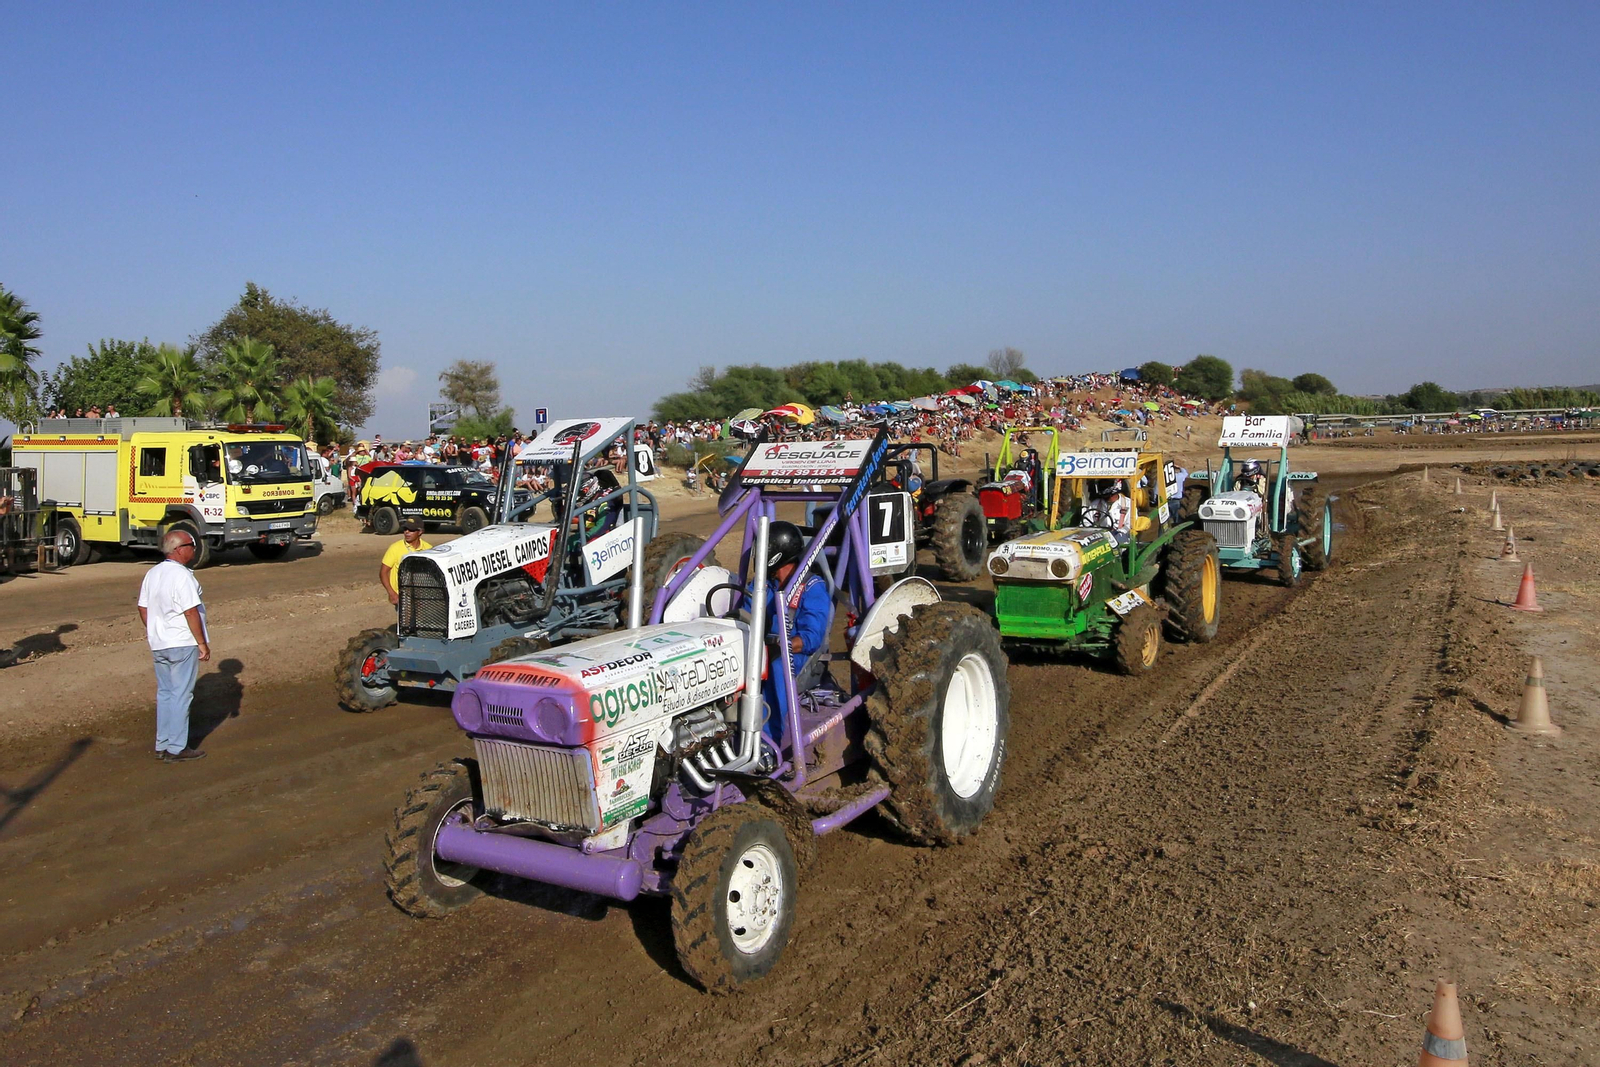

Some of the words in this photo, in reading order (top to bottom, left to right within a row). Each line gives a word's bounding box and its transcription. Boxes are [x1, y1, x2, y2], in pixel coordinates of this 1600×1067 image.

[1245, 416, 1265, 426] Bar
[1222, 429, 1235, 438] La
[1241, 429, 1282, 438] Familia
[638, 451, 648, 473] 8
[765, 450, 862, 460] DESGUACE
[1164, 462, 1175, 483] 15
[204, 508, 222, 517] R-32
[879, 502, 893, 537] 7
[807, 518, 836, 568] Valdepeñas
[448, 559, 479, 587] TURBO
[482, 549, 513, 576] DIESEL
[515, 536, 548, 563] CAMPOS
[455, 608, 472, 618] MIGUEL
[454, 619, 475, 631] CACERES
[480, 670, 515, 682] TALLER
[514, 672, 561, 688] HOMER
[590, 672, 658, 728] agrosil
[662, 698, 685, 713] Estudio
[687, 695, 692, 705] &
[692, 688, 711, 704] diseño
[712, 681, 719, 695] de
[720, 677, 738, 691] cocinas
